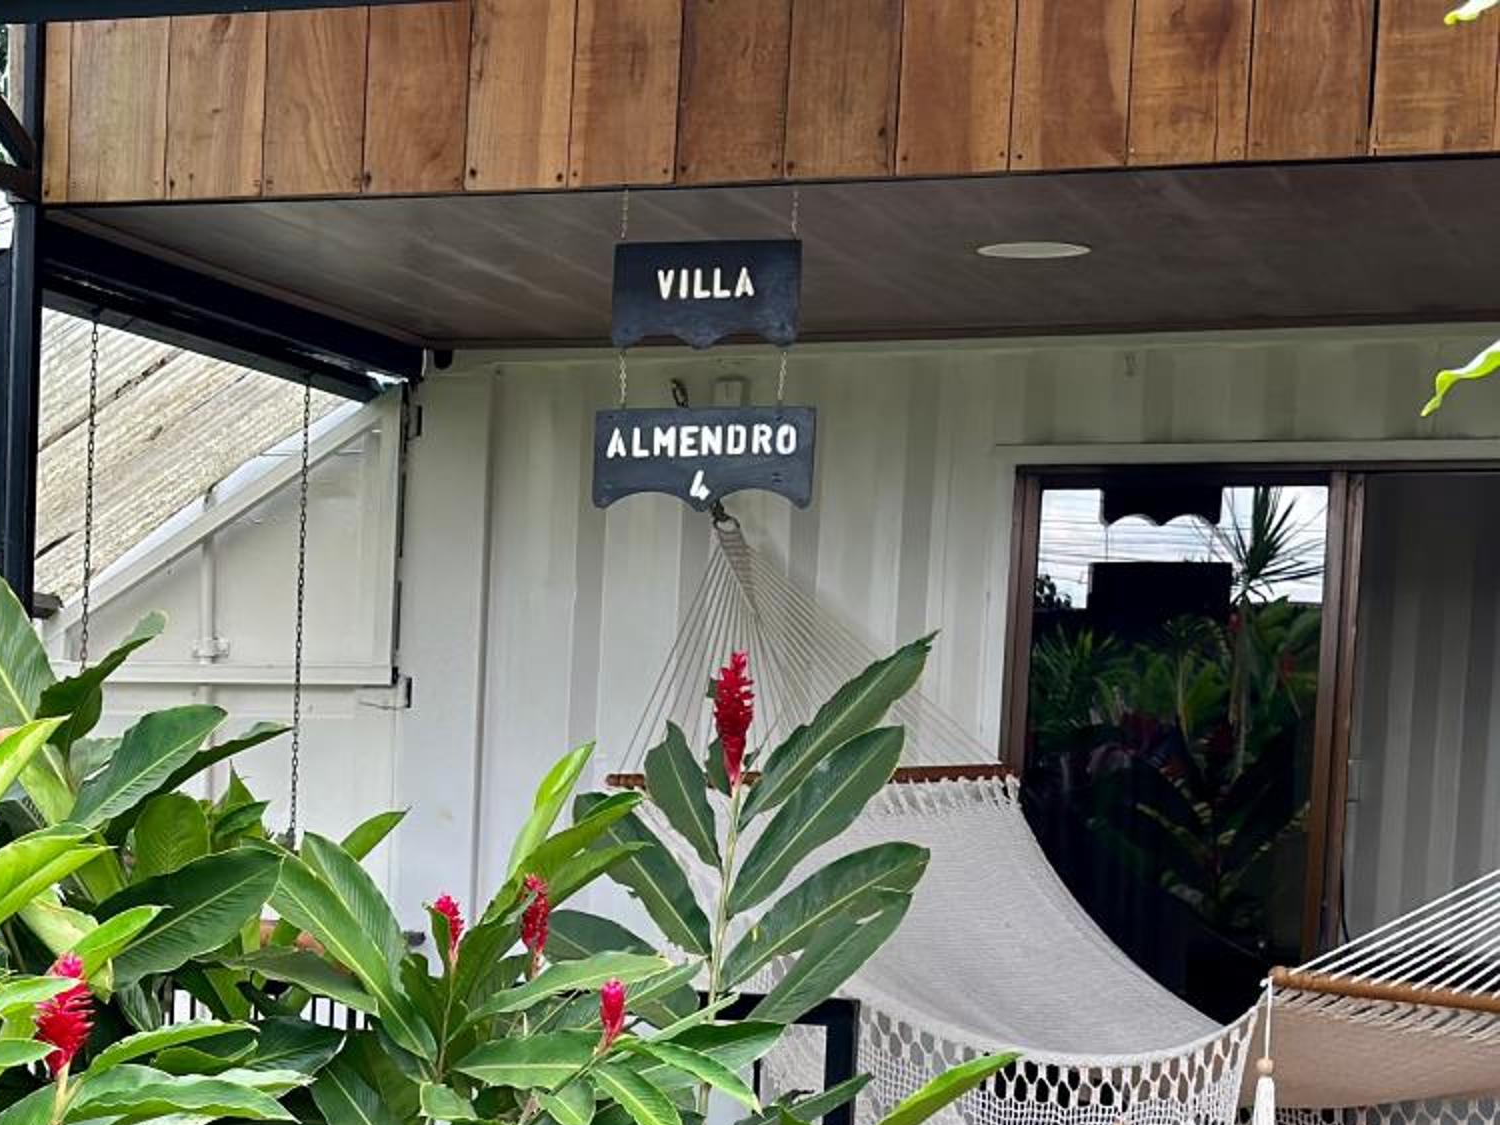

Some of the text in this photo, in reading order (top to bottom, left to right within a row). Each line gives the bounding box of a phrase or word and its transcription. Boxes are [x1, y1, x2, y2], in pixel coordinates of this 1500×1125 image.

[657, 267, 754, 300] VILLA
[606, 423, 797, 459] ALMENDRO
[689, 469, 710, 500] 4
